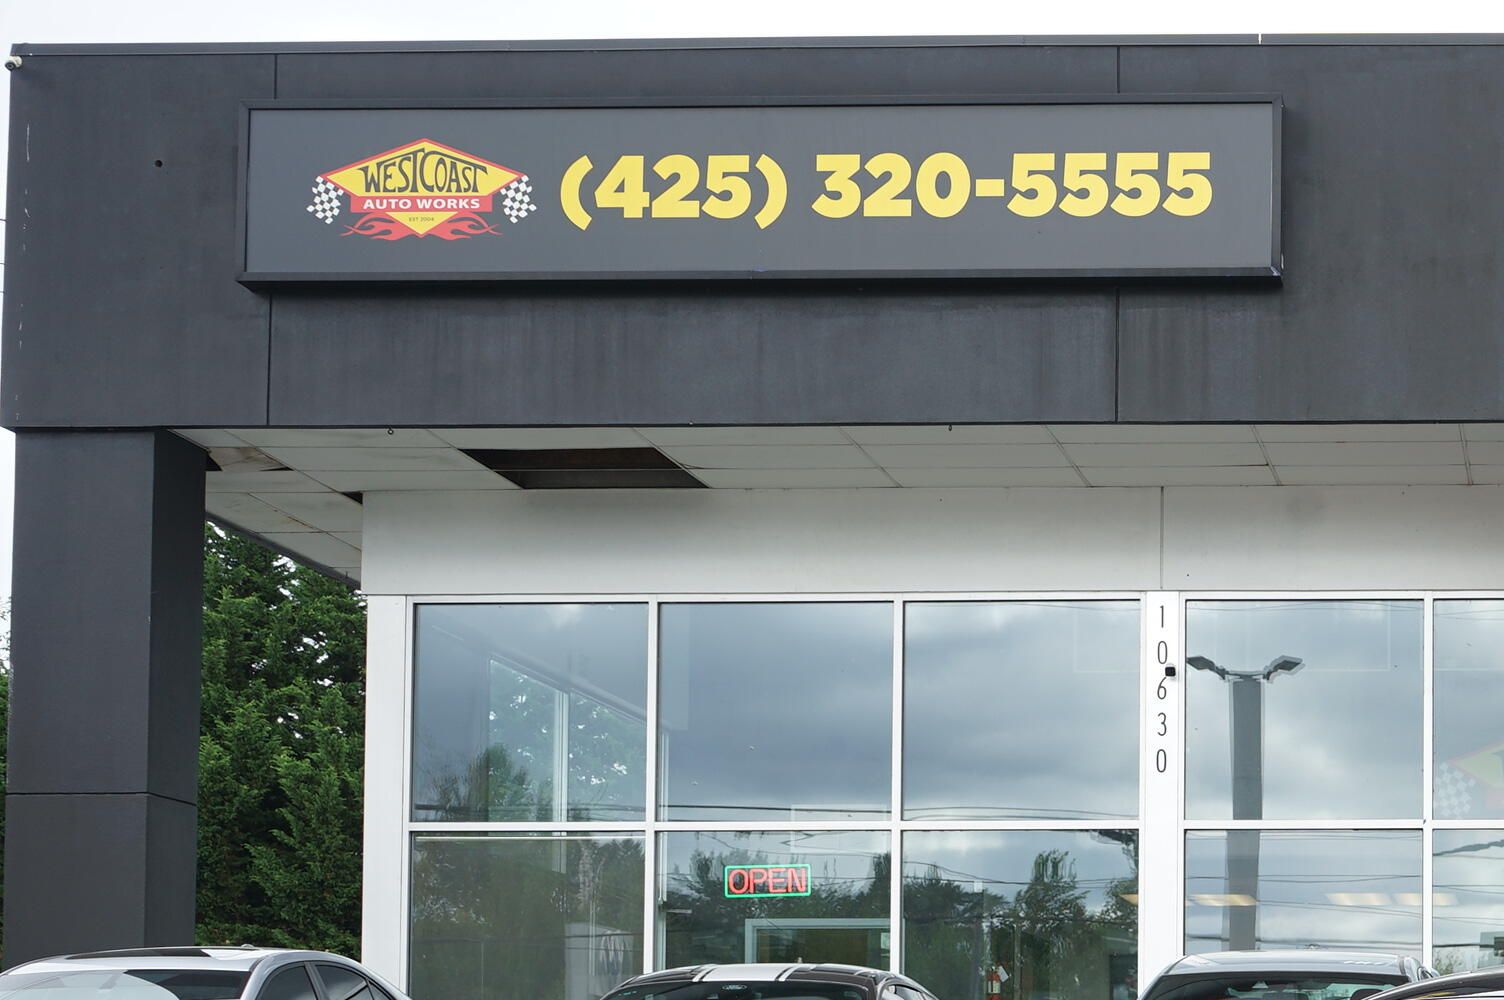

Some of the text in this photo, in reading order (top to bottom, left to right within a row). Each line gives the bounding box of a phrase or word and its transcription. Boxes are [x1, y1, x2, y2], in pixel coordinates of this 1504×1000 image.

[363, 198, 480, 210] AUTO WORKS
[560, 151, 1213, 231] (425) 320-5555
[728, 868, 806, 894] OPEN
